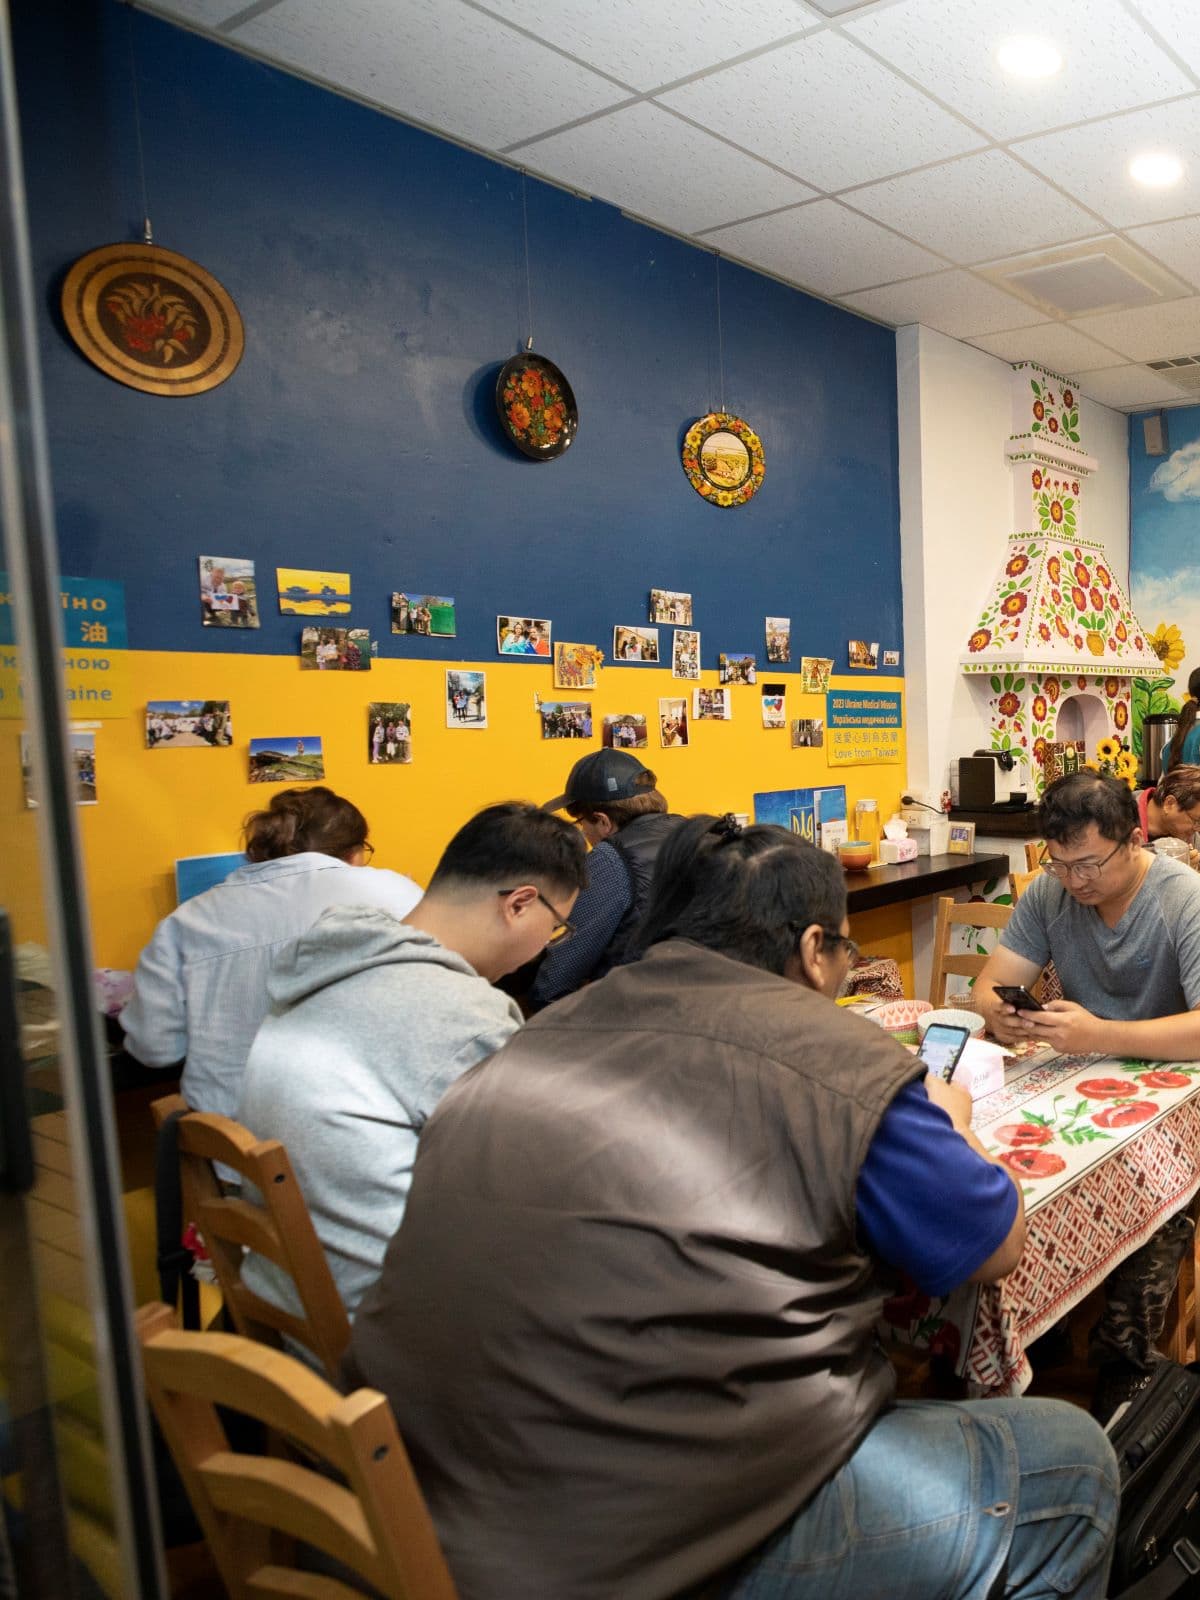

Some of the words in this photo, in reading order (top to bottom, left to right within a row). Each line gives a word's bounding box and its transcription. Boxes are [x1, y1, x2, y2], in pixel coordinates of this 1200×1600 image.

[845, 698, 863, 709] Ukraine
[863, 699, 880, 709] Medical
[880, 699, 897, 710] Mission
[834, 748, 853, 759] Love
[854, 747, 872, 758] from
[873, 747, 898, 758] Taiwan
